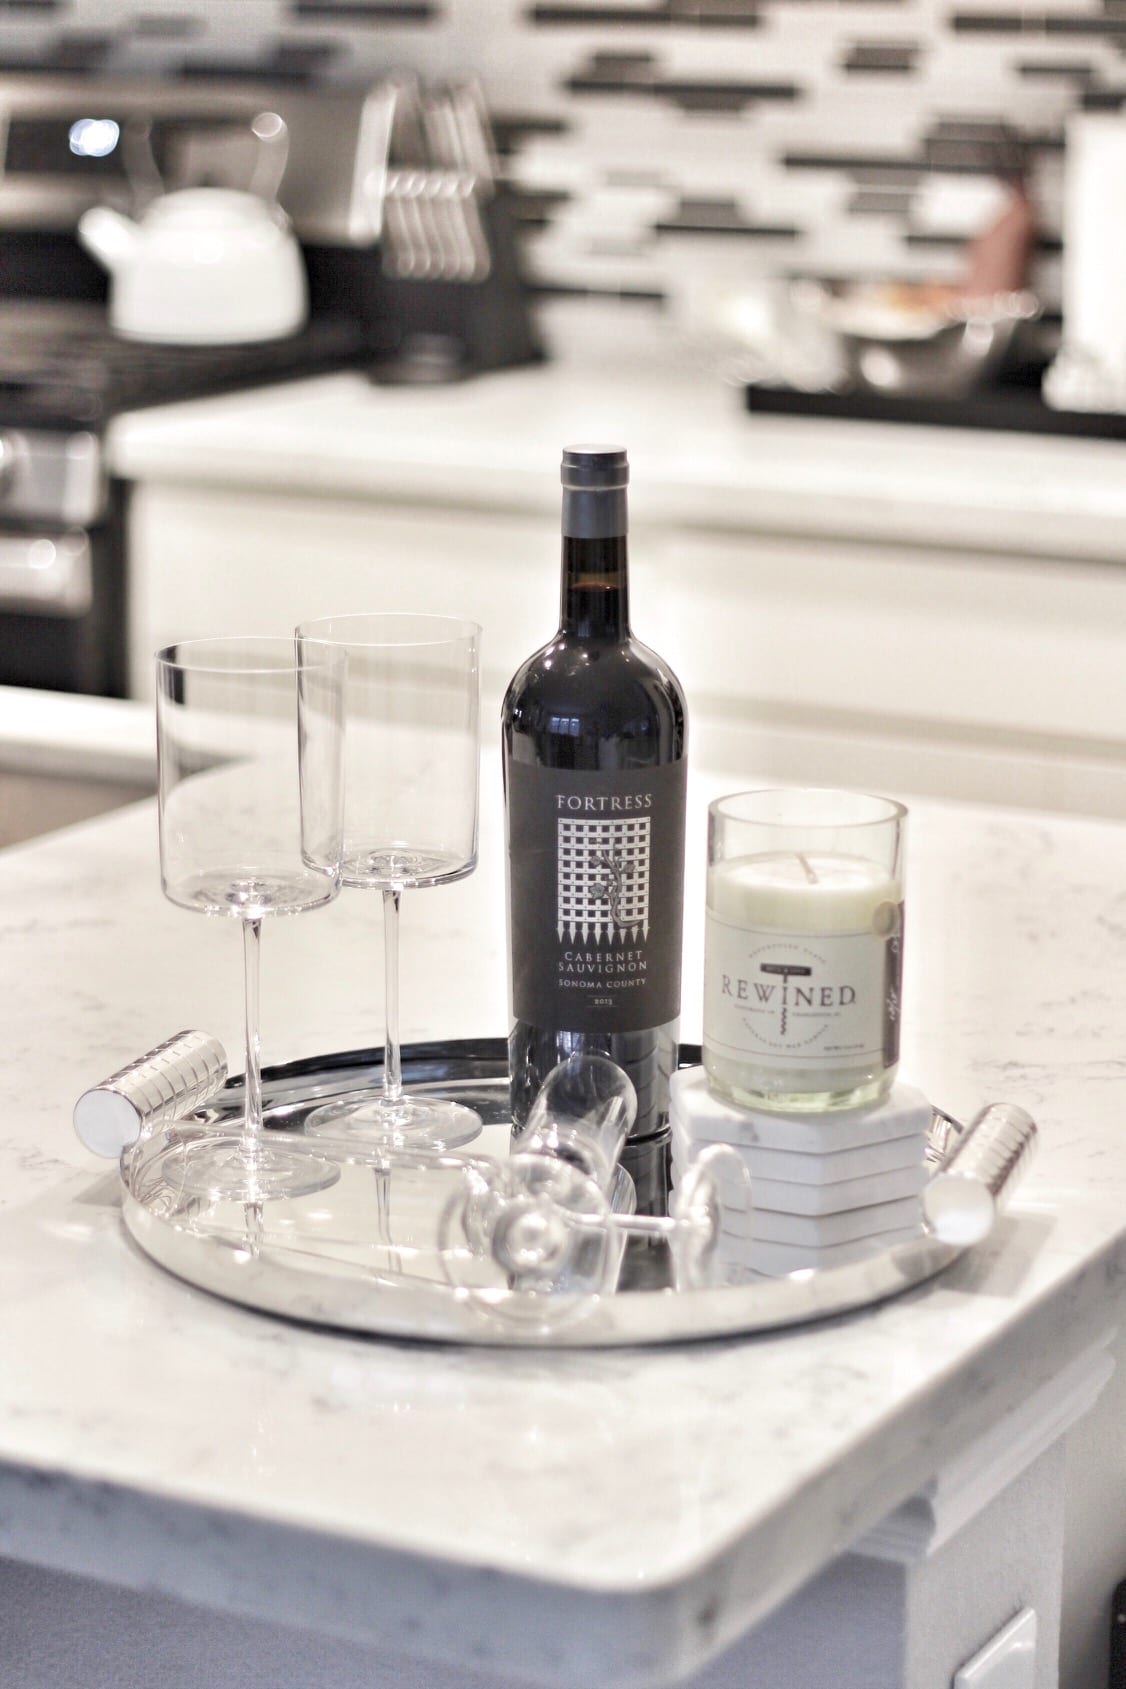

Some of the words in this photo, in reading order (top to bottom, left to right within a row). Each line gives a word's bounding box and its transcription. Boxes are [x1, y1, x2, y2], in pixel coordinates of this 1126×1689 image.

[556, 793, 653, 811] FORTRESS
[564, 950, 643, 962] CABERNET
[559, 961, 647, 974] SAUVIGNON
[558, 978, 602, 989] SONOMA
[606, 977, 647, 988] COUNTY
[721, 974, 857, 1007] REWINED
